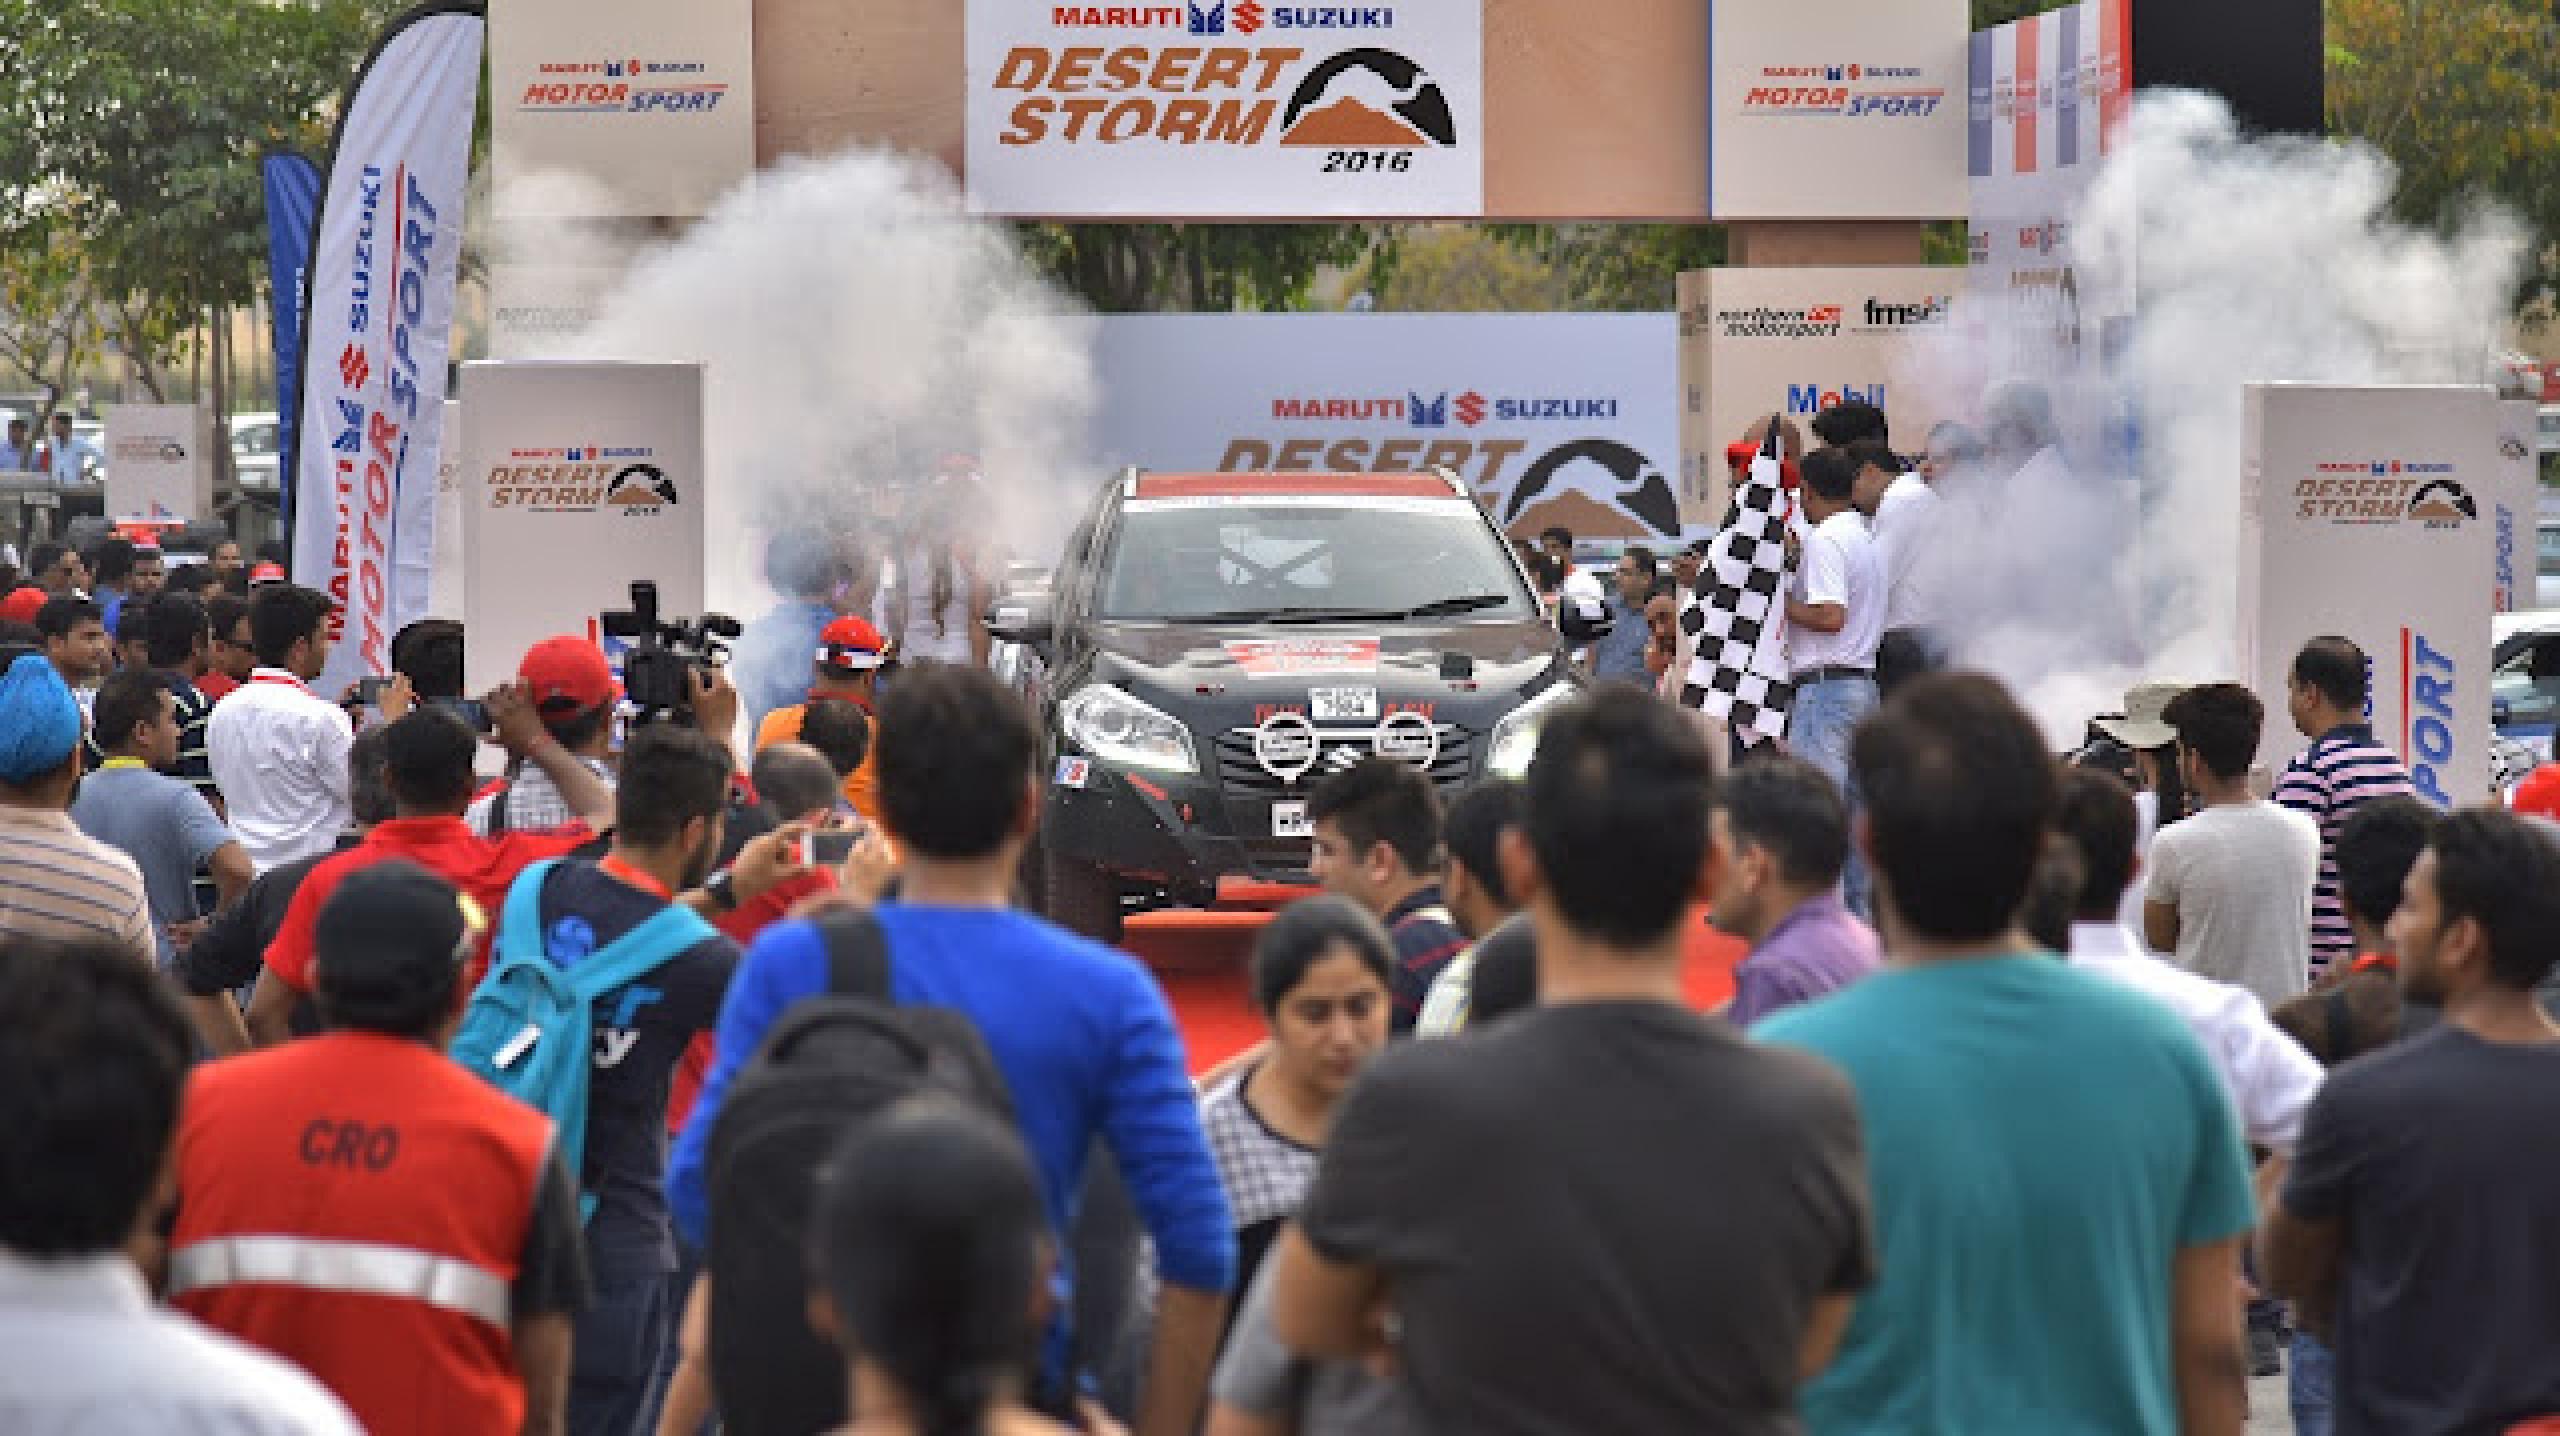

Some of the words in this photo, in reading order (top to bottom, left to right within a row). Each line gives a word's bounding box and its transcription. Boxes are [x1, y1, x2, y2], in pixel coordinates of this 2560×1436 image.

[1052, 7, 1183, 28] MARUTI
[1271, 7, 1393, 28] SUZUKI
[992, 46, 1304, 92] DESERT
[519, 83, 629, 105] MOTOR
[627, 91, 726, 113] SPORT
[1743, 87, 1849, 107] MOTOR
[1846, 95, 1942, 117] SPORT
[1000, 97, 1281, 145] STORM
[1320, 151, 1413, 173] 2016
[328, 459, 354, 643] MARUTI
[348, 164, 382, 333] SUZUKI
[1272, 399, 1404, 420] MARUTI
[1495, 399, 1618, 420] SUZUKI
[360, 411, 399, 680] MOTOR
[391, 171, 437, 421] SPORT
[488, 463, 617, 485] DESERT
[2295, 479, 2417, 497] DESERT
[489, 487, 605, 508] STORM
[2295, 499, 2406, 520] STORM
[2411, 634, 2456, 806] PORT
[302, 1117, 397, 1170] CRO
